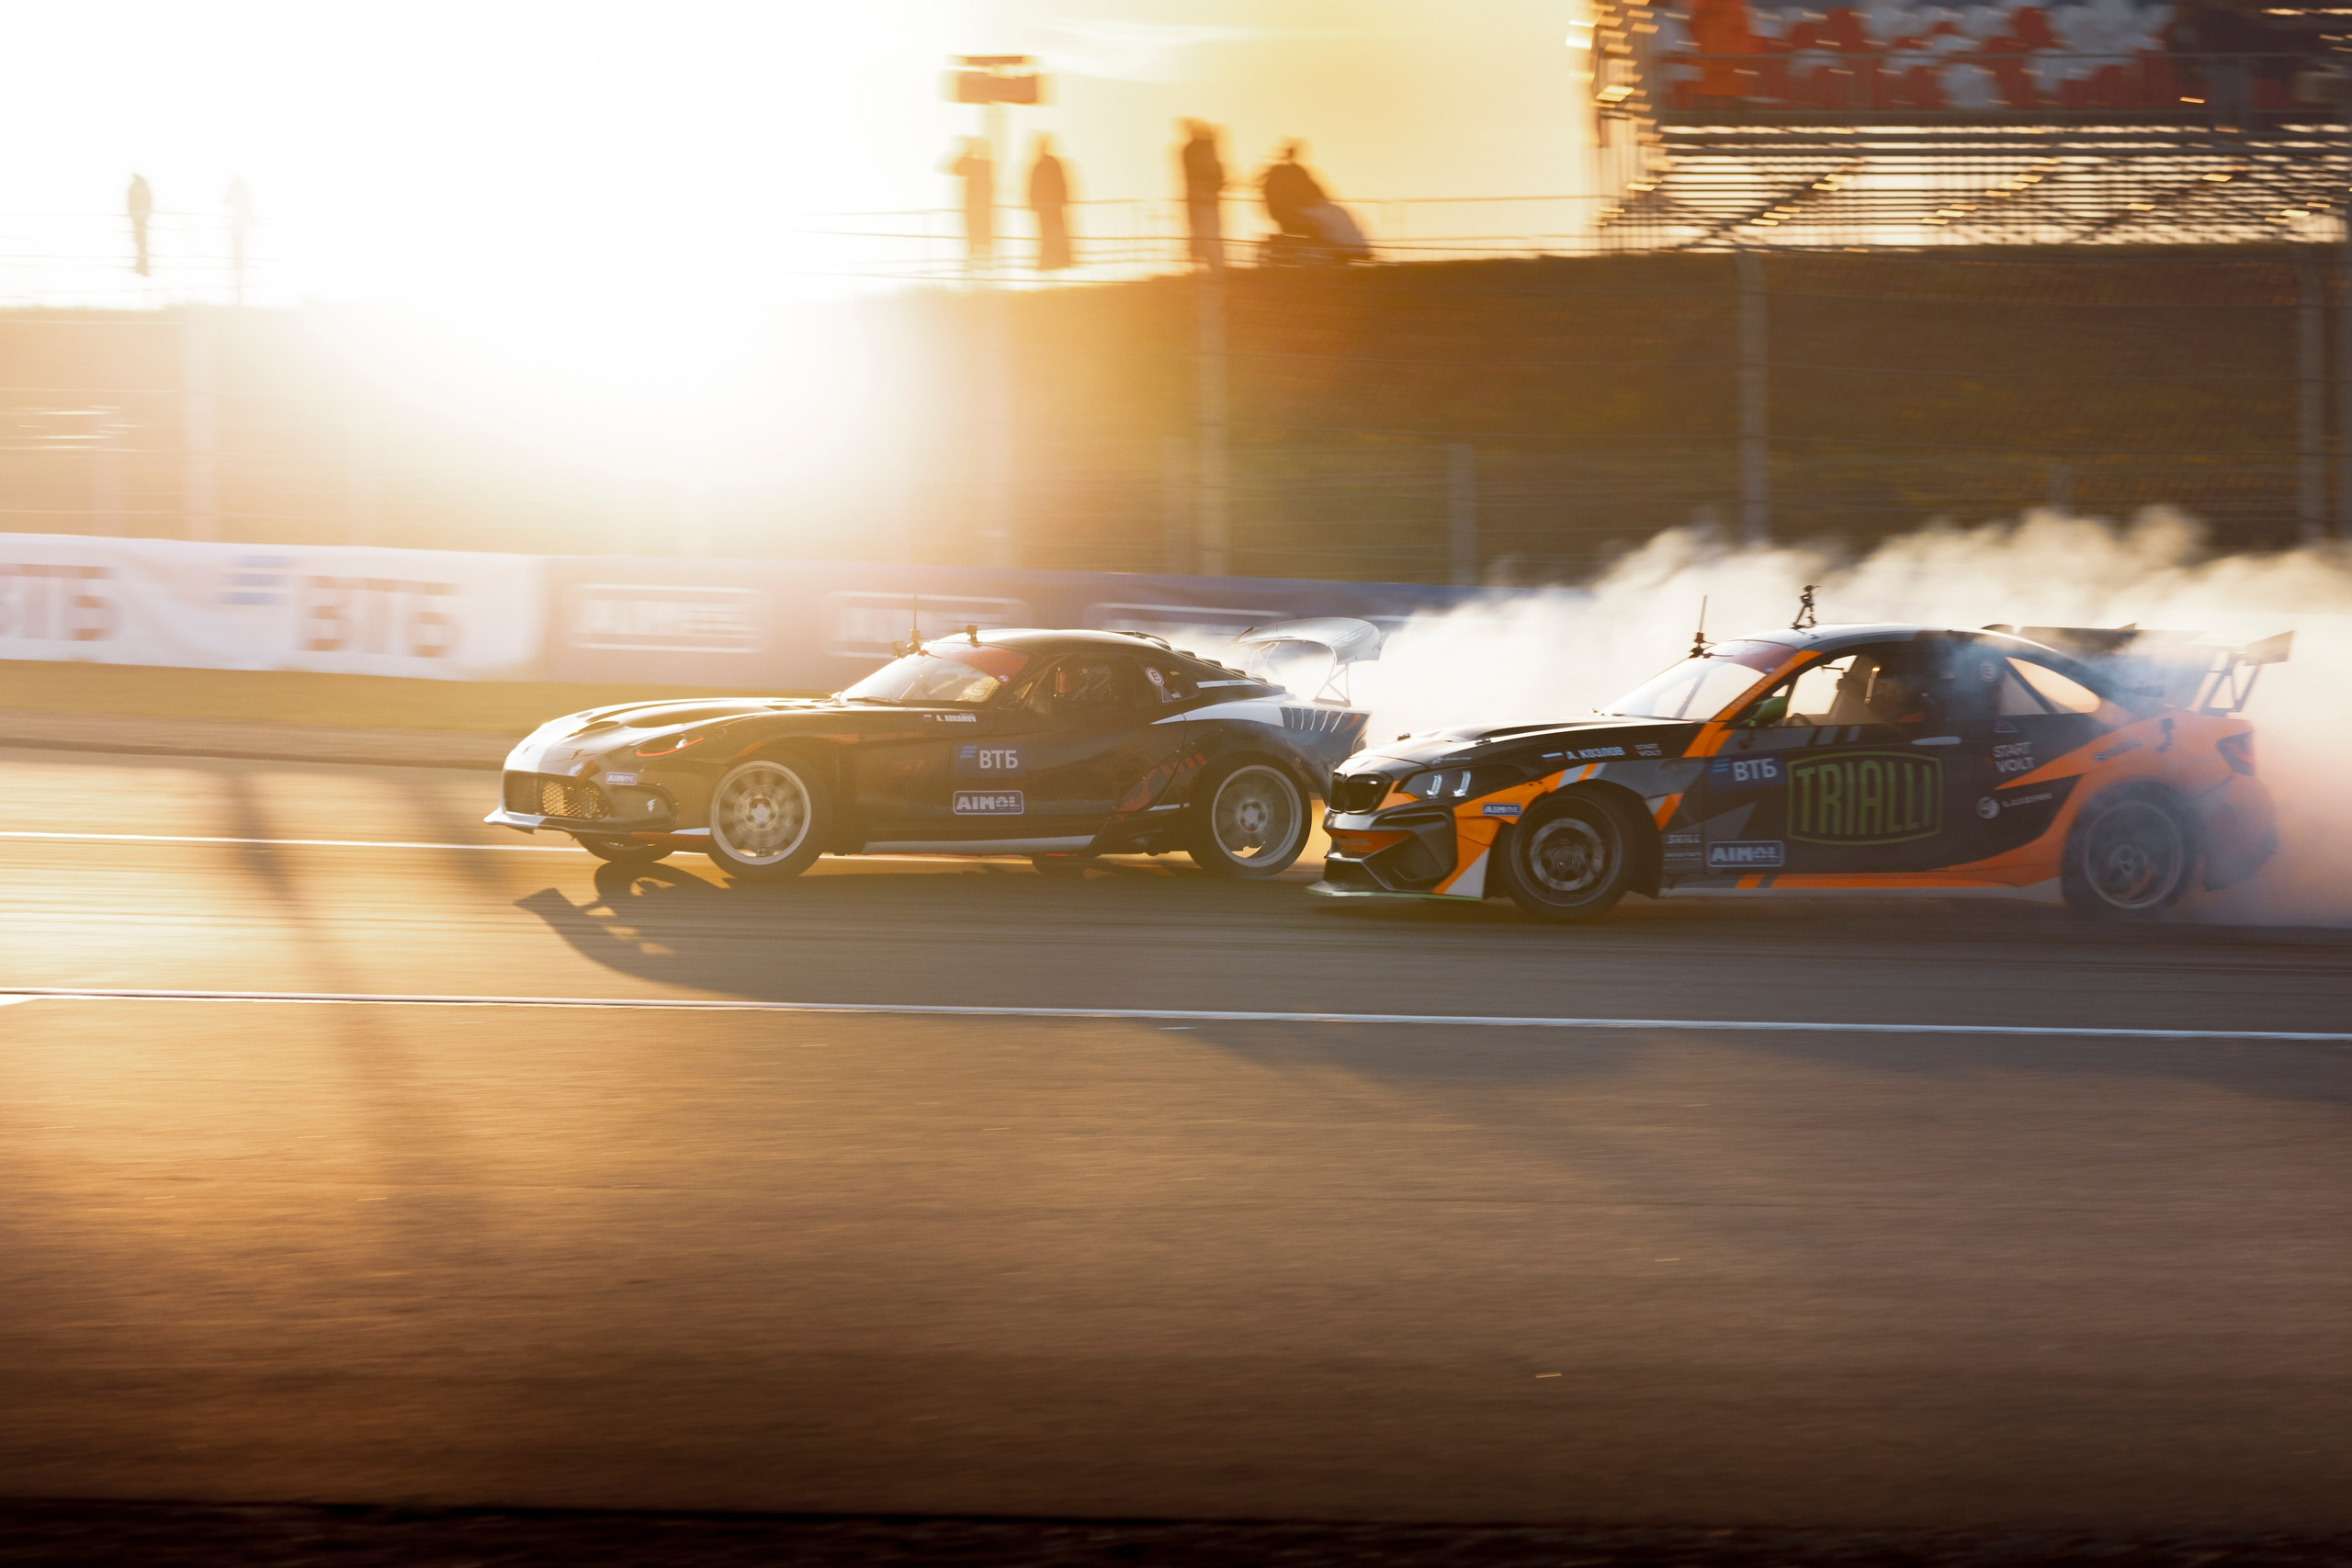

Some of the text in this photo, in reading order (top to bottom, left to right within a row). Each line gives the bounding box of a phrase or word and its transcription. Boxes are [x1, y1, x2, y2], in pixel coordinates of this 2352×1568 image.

[1566, 746, 1626, 761] А. КОЗЛОВ
[1638, 749, 1662, 757] VOLT
[1993, 741, 2031, 758] START
[978, 750, 1019, 769] ВТБ
[1995, 757, 2035, 773] VOLT
[1732, 758, 1779, 782] ВТБ
[956, 795, 1021, 810] AIMOL
[1795, 760, 1933, 835] TRIALLI
[1711, 846, 1781, 862] AIMOL
